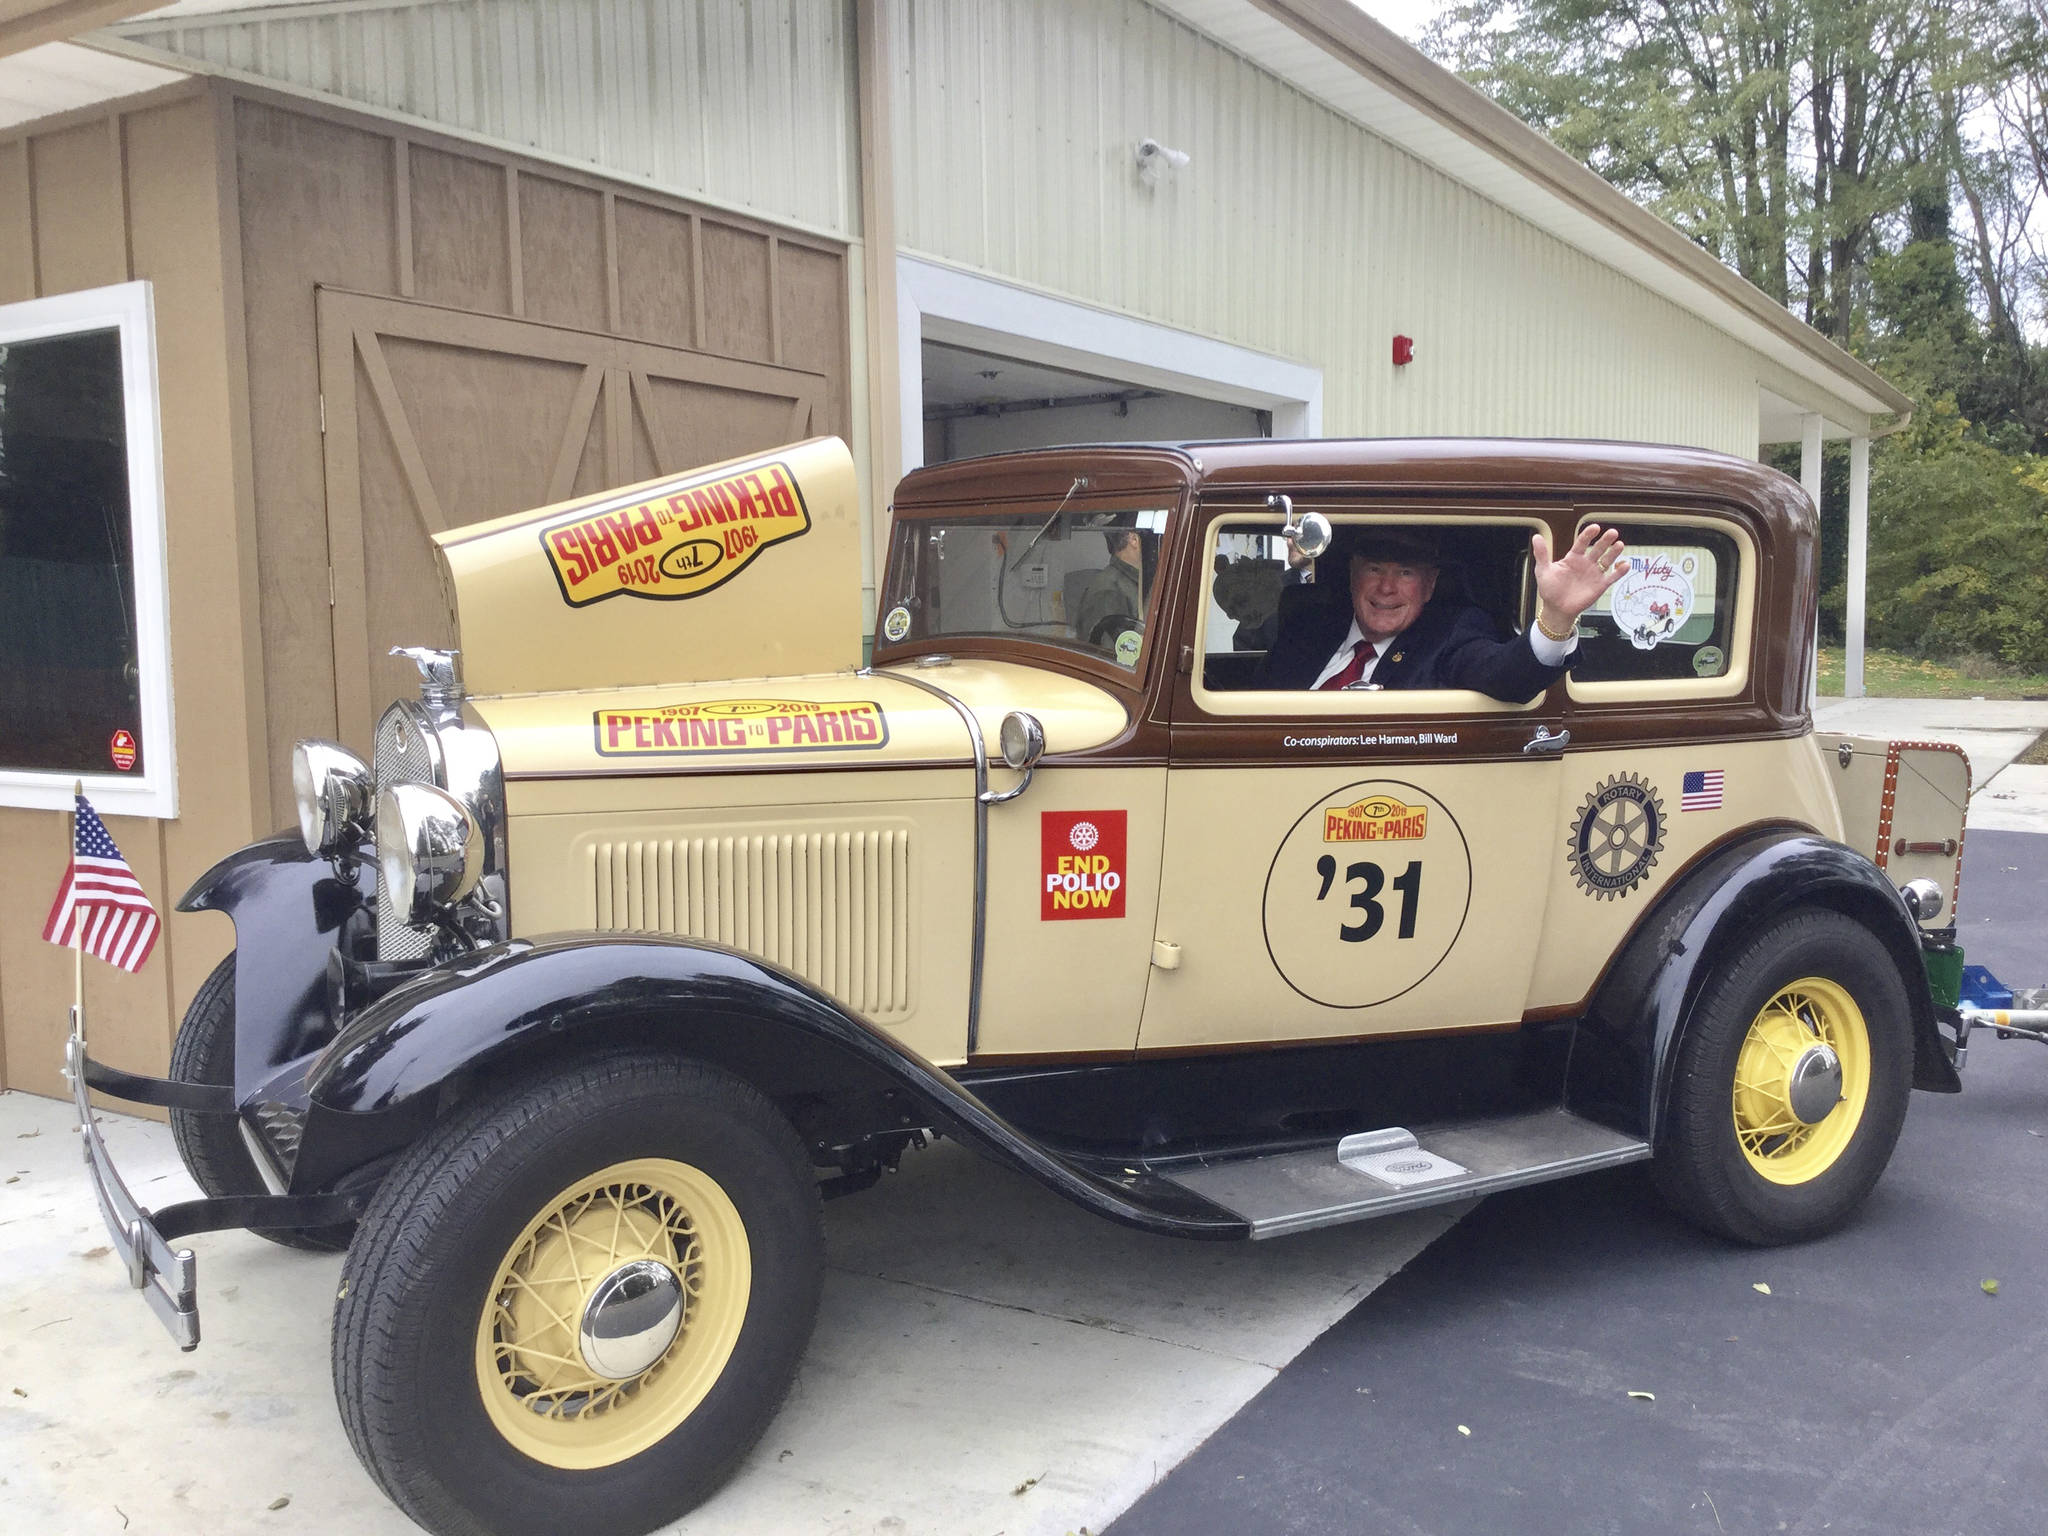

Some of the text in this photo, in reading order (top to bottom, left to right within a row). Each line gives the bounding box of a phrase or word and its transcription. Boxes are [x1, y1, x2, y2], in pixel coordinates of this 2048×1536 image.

[551, 469, 797, 586] PEKING TO PARIS
[617, 525, 759, 585] 1907 7th 2019
[1645, 554, 1675, 581] Vicky
[661, 707, 700, 716] 1907
[777, 703, 820, 713] 2019
[607, 707, 878, 747] PEKING TO PARIS
[1284, 733, 1458, 748] Co-conspirators: Lee Harman, Bill Ward
[1602, 786, 1643, 803] ROTARY
[1348, 805, 1364, 818] 1907
[1391, 804, 1407, 817] 2019
[1326, 815, 1377, 840] PEKING
[1384, 813, 1425, 839] PARIS
[1058, 855, 1110, 875] END
[1581, 852, 1650, 888] INTERNATIONAL
[1046, 872, 1120, 892] POLIO
[1053, 889, 1113, 909] NOW
